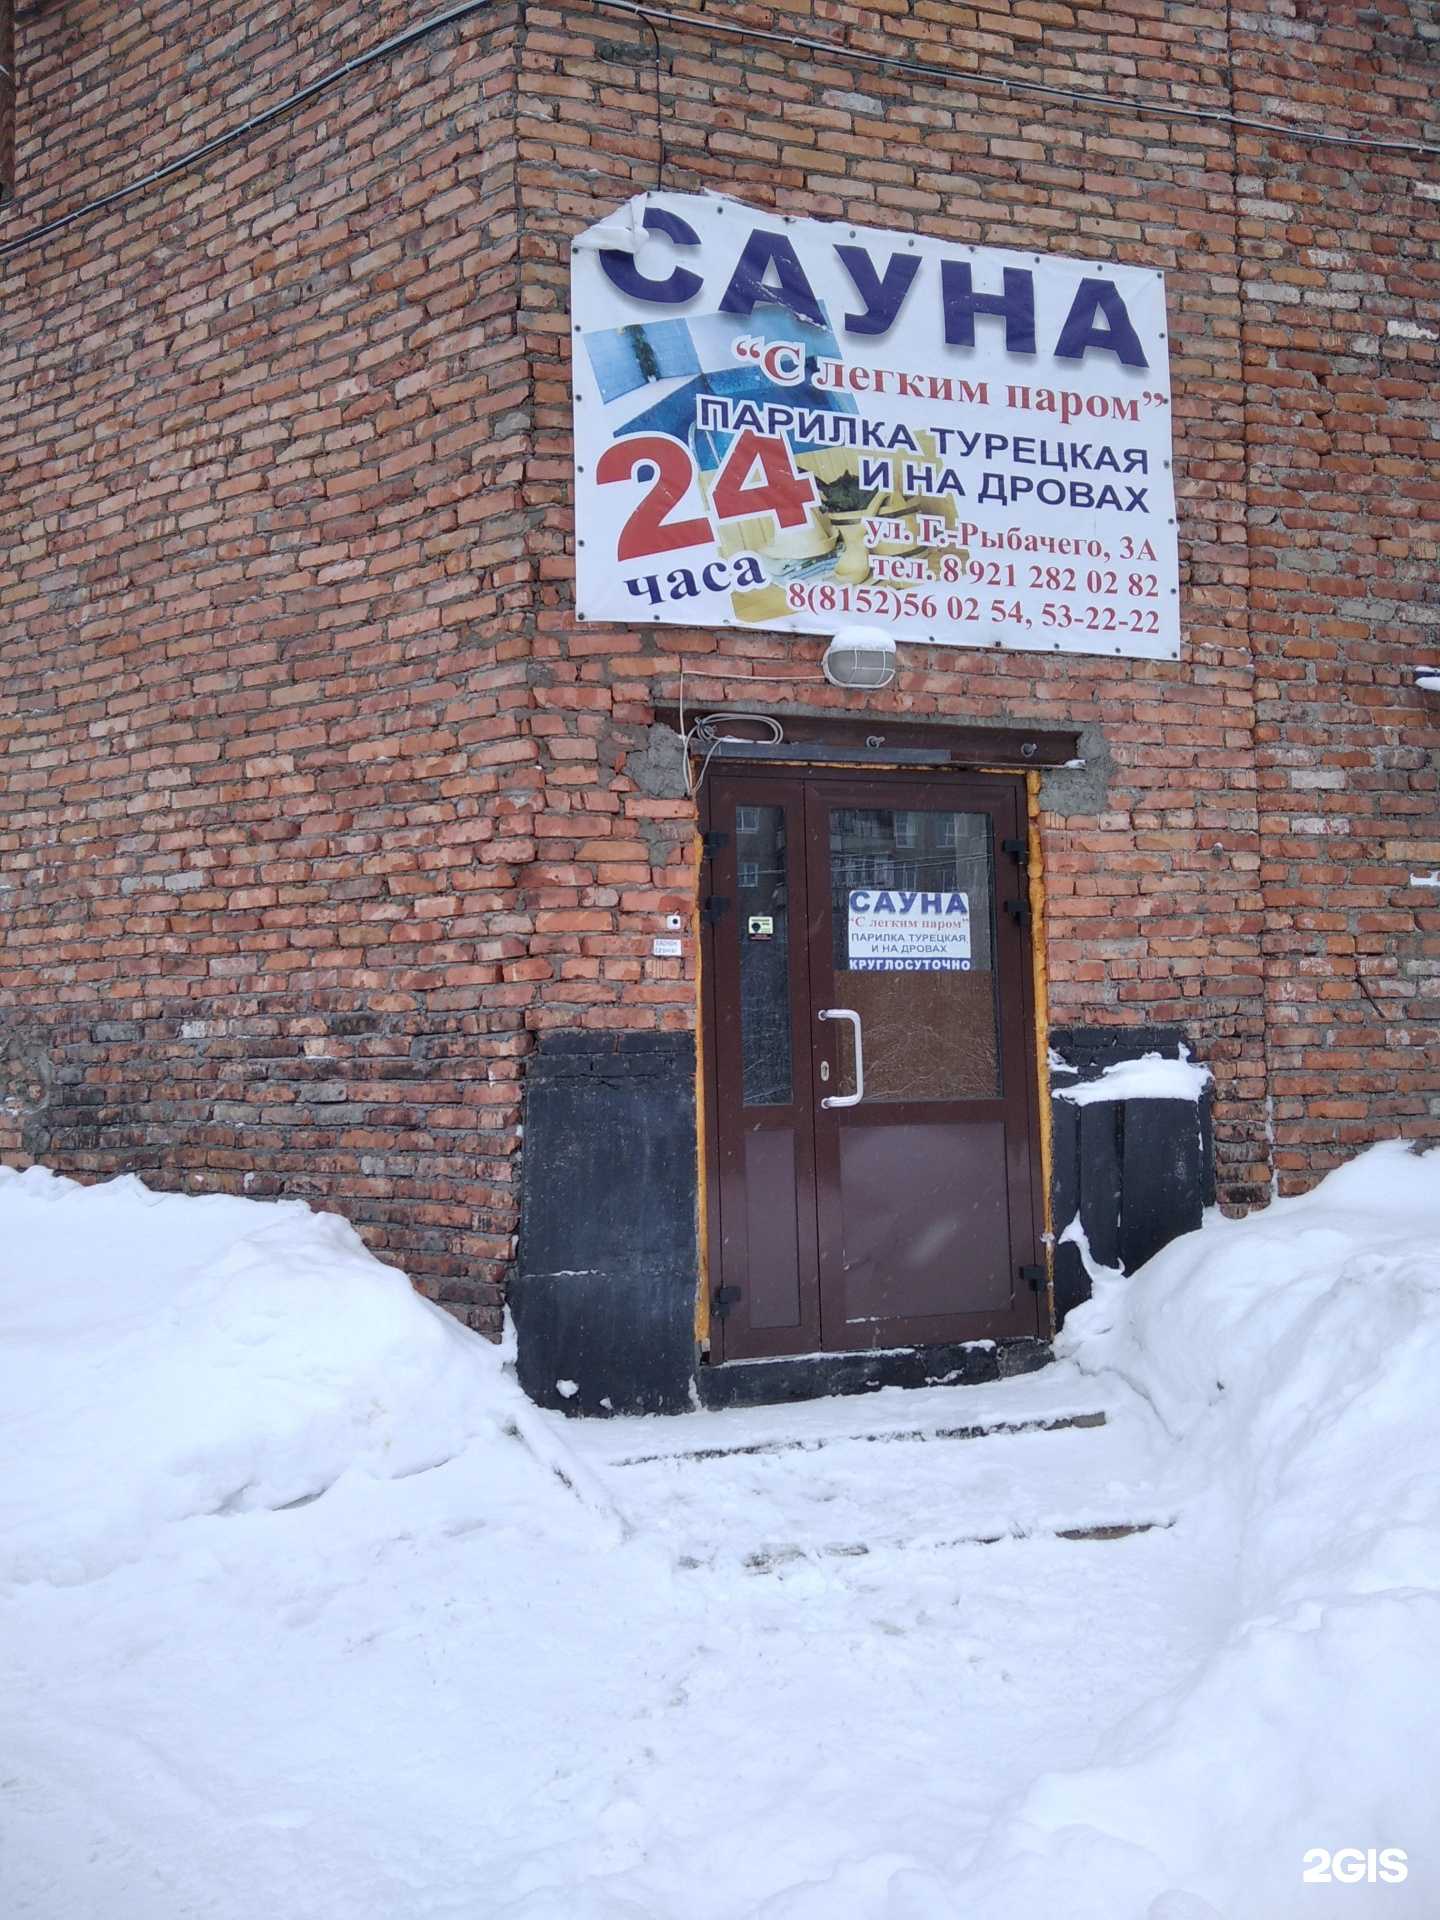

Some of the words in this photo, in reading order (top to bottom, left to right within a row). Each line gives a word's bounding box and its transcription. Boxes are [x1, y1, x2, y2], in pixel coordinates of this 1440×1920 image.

[599, 207, 1149, 369] САУНА
[816, 360, 989, 405] легким
[701, 398, 917, 450] ПАРИЛКА
[930, 428, 1149, 475] ТУРЕЦКАЯ
[596, 429, 816, 562] 24
[864, 461, 890, 489] И
[907, 464, 965, 497] НА
[978, 472, 1150, 514] ДРОВАХ
[865, 519, 911, 544] ул.
[1119, 535, 1159, 562] 3А
[625, 554, 766, 605] часа
[872, 558, 933, 581] тел.
[943, 558, 960, 583] 8
[968, 562, 1017, 587] 921
[1029, 565, 1077, 593] 282
[1086, 569, 1119, 595] 02
[1128, 572, 1160, 598] 82
[788, 582, 938, 621] 8(8152)56
[947, 596, 980, 621] 02
[990, 599, 1033, 629] 54,
[1041, 603, 1160, 634] 53-22-22
[850, 891, 968, 914] САУНА
[869, 919, 917, 928] легким
[851, 933, 905, 942] ПАРИЛКА
[882, 945, 898, 953] НА
[901, 945, 948, 953] ДРОВАХ
[850, 959, 971, 971] КРУГЛОСУТОЧНО
